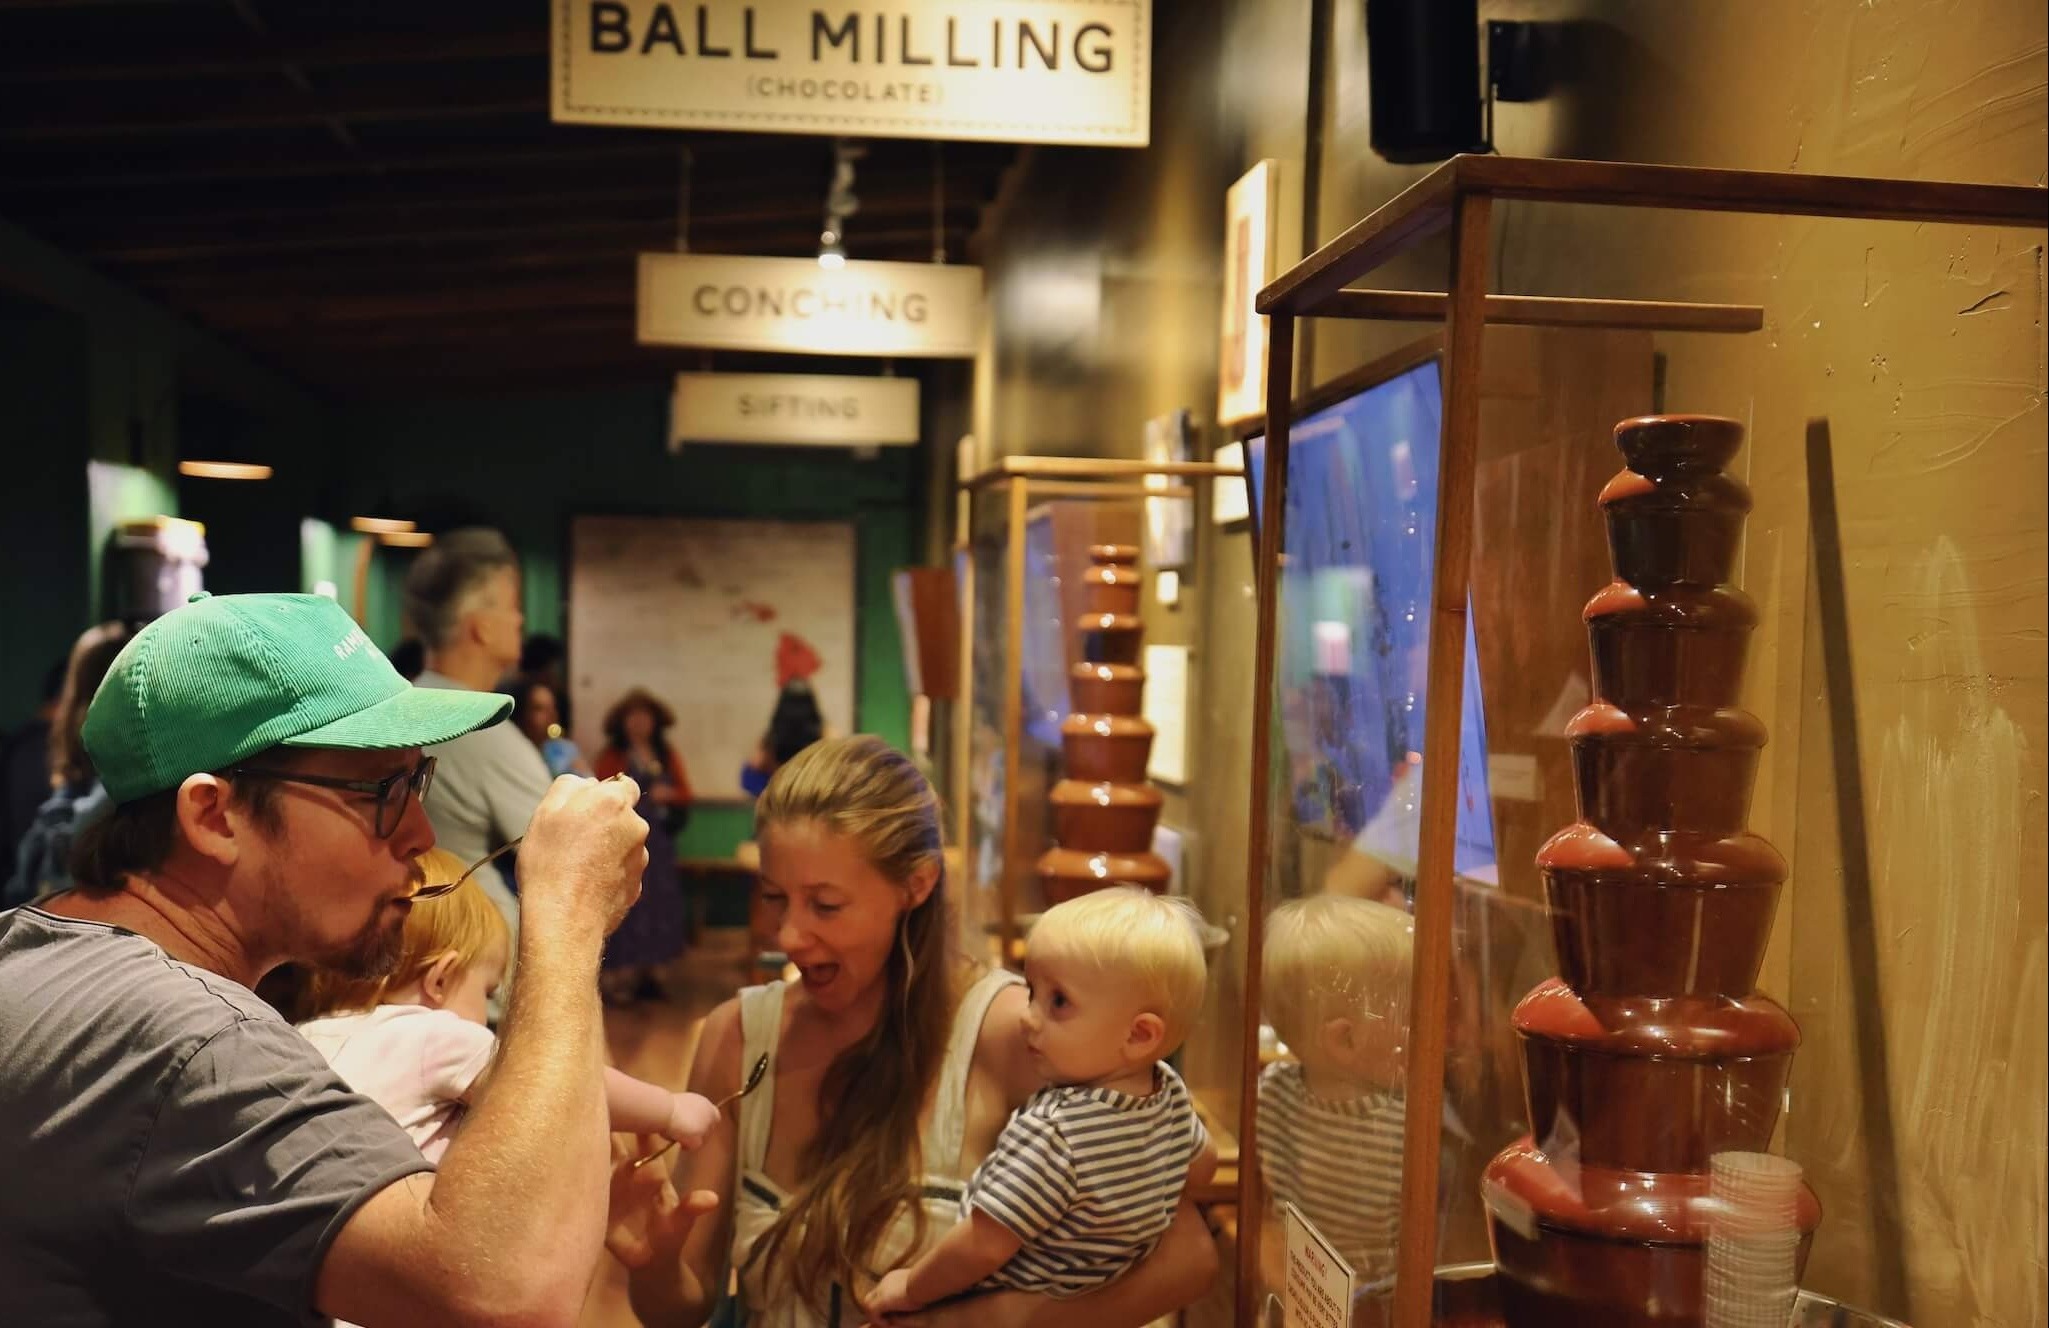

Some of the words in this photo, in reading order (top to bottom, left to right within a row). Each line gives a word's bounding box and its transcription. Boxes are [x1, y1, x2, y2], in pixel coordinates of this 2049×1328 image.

[590, 1, 778, 60] BALL
[811, 11, 1113, 73] MILLING
[693, 284, 928, 322] CONCHING
[737, 394, 860, 420] SIFTING
